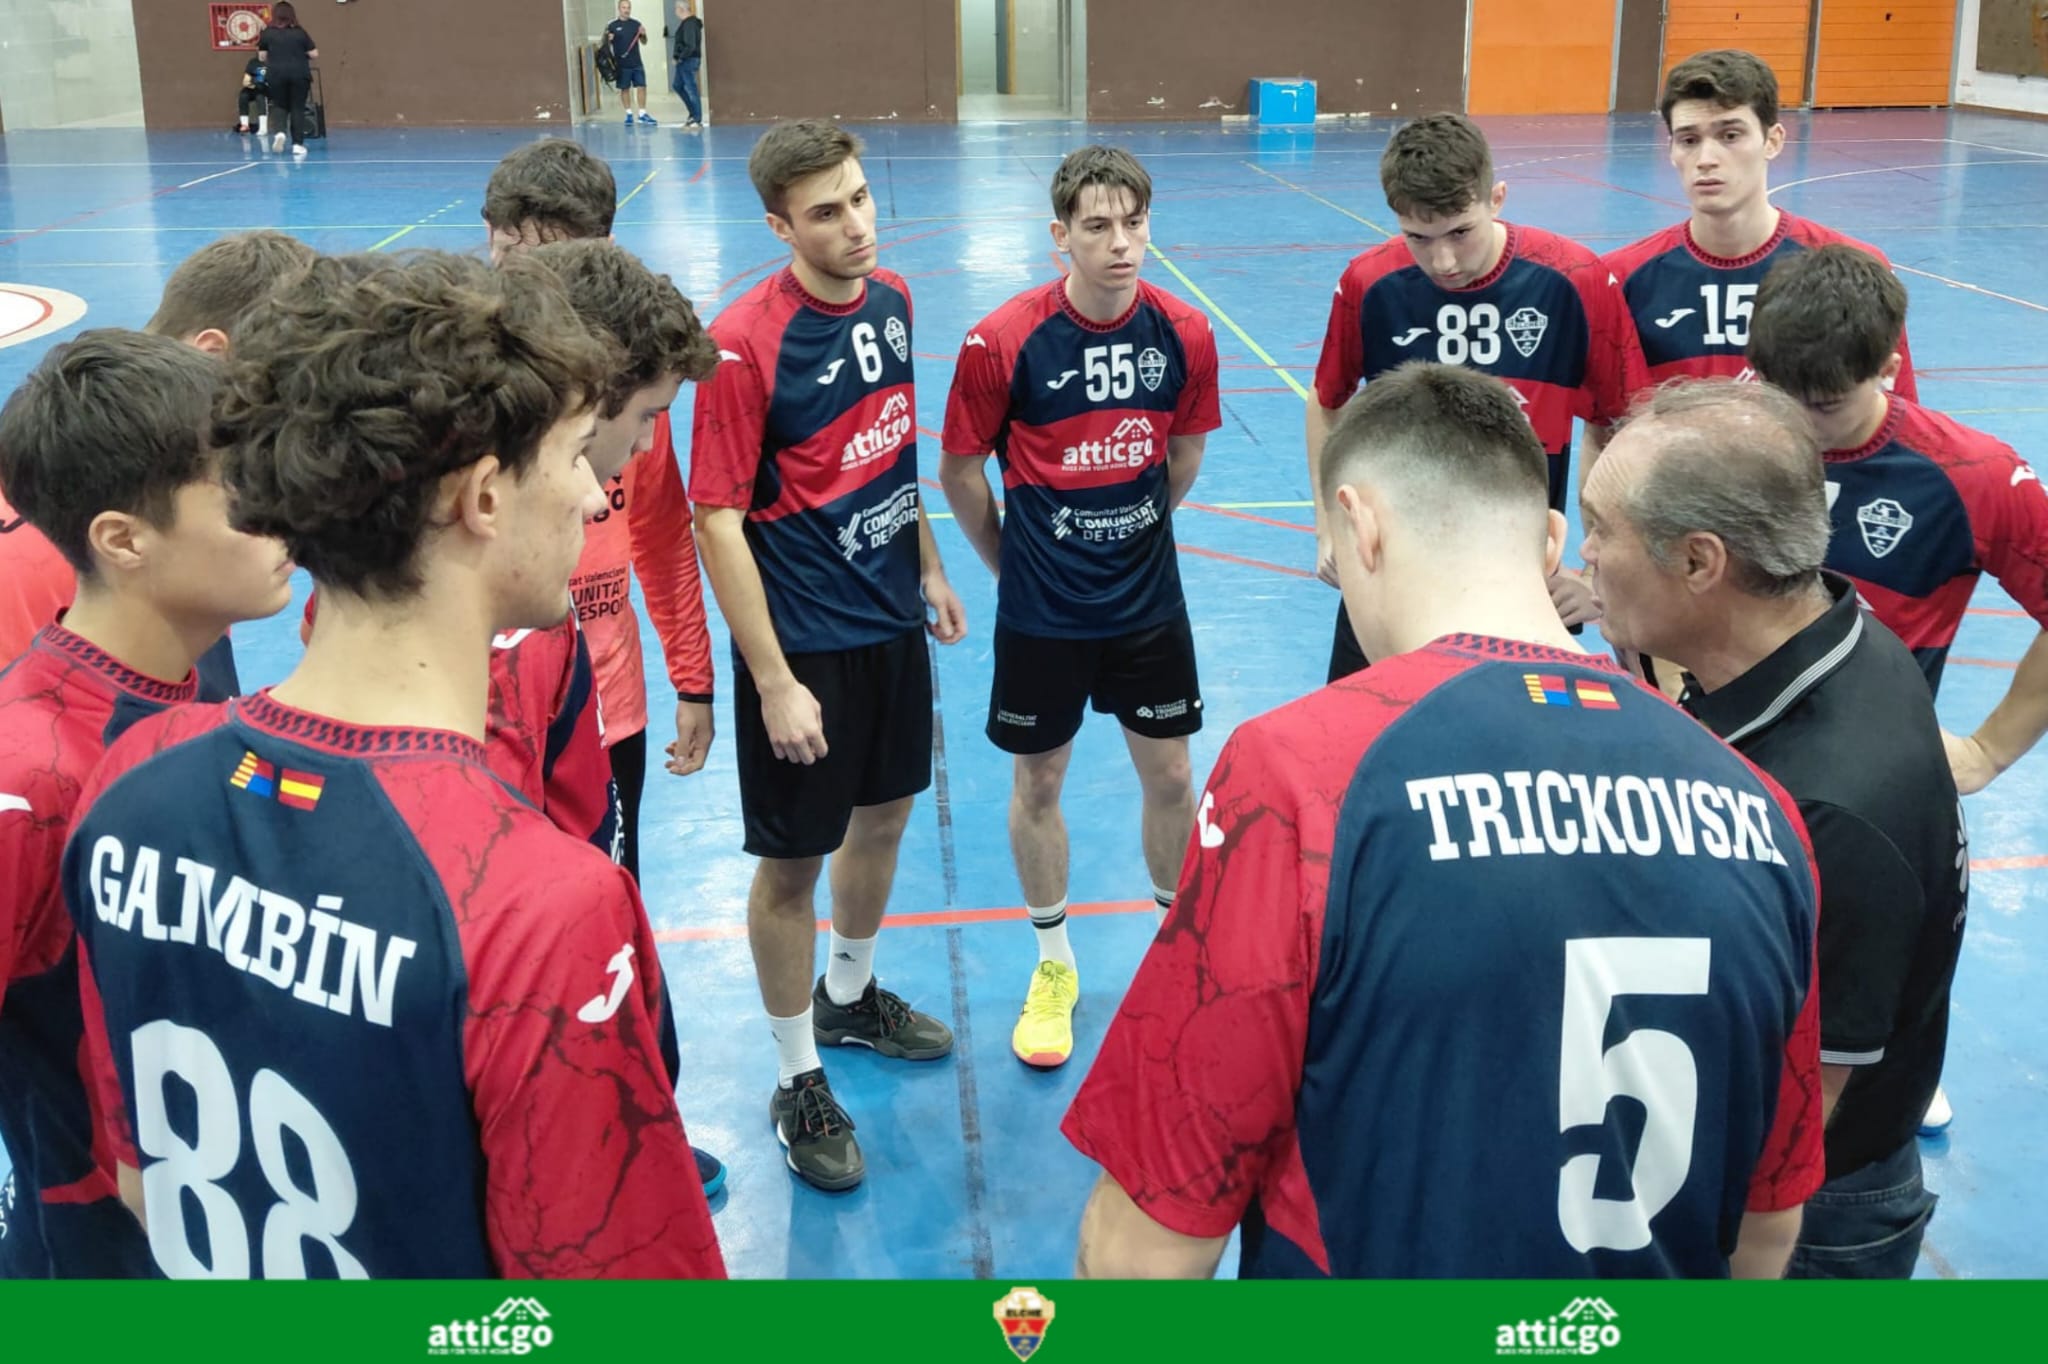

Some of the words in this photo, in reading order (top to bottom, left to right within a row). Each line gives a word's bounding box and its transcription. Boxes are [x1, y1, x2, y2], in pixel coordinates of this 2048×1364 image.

[1437, 303, 1501, 365] 83
[1700, 284, 1759, 345] 15
[851, 322, 883, 383] 6
[1084, 344, 1135, 402] 55
[841, 414, 911, 464] atticgo
[1063, 436, 1153, 467] atticgo
[870, 528, 889, 549] DE
[1083, 530, 1104, 541] DE
[572, 578, 624, 606] UNITAT
[1405, 770, 1788, 867] TRICKOVSKI
[90, 835, 417, 1027] GAMBÍN
[1558, 937, 1711, 1254] 5
[131, 1019, 371, 1279] 88
